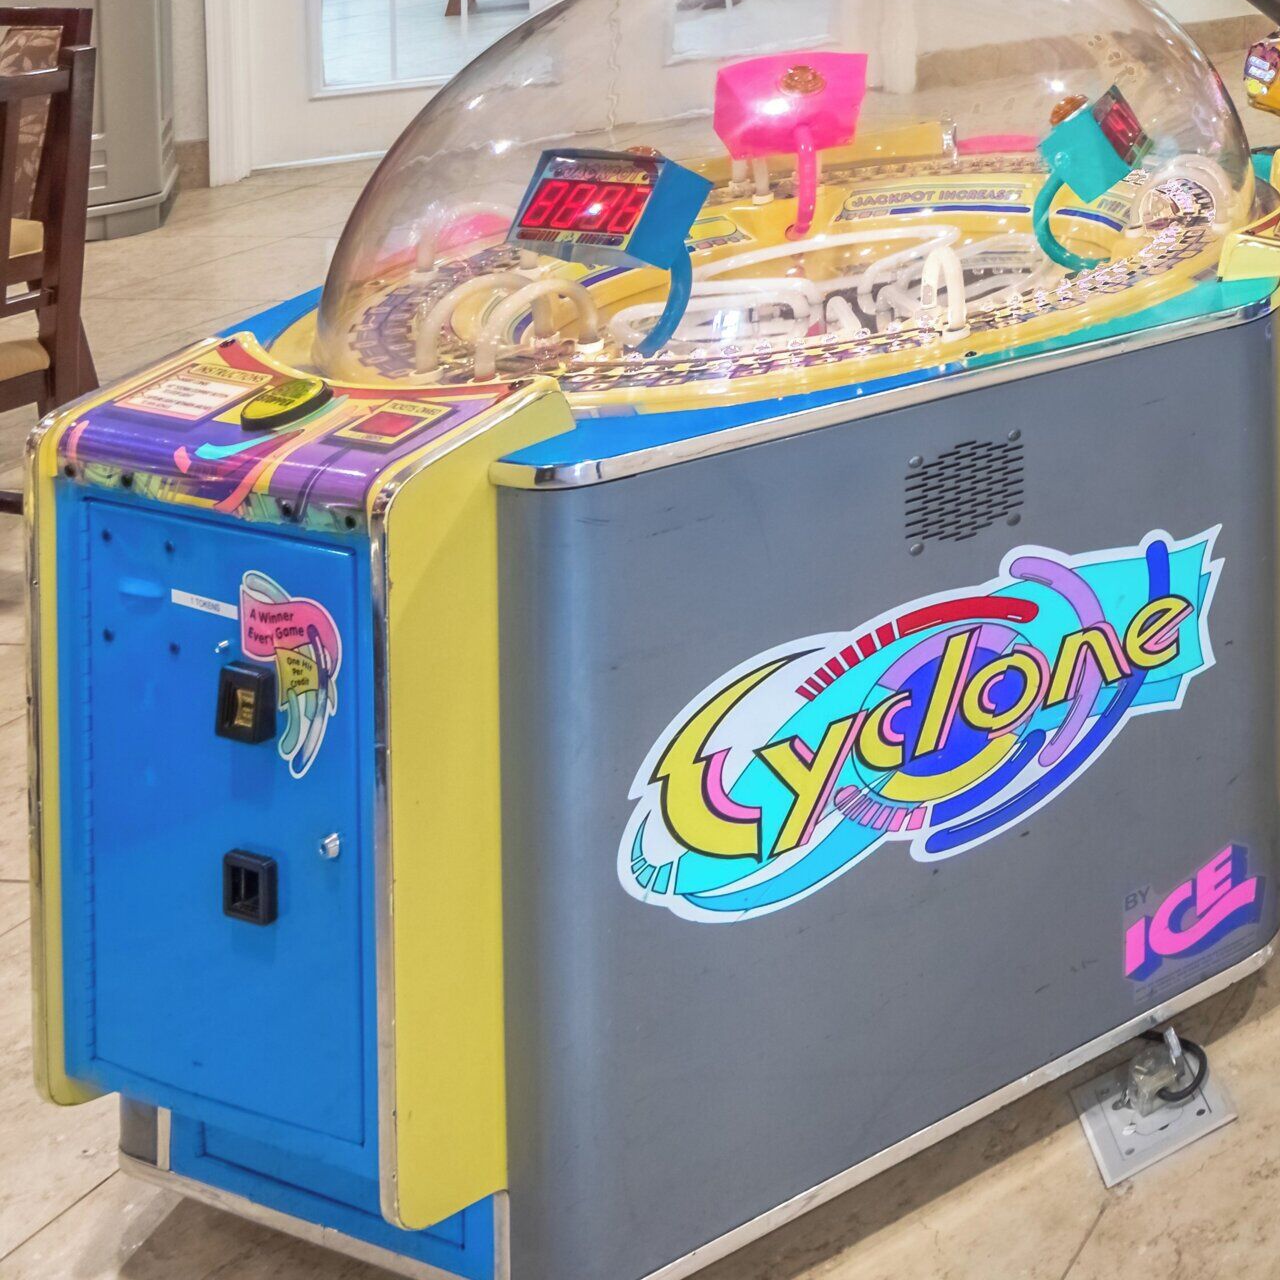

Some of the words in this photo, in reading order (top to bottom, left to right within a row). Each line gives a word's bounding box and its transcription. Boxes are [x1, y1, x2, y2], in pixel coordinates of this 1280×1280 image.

[558, 163, 640, 183] JACKPOT
[852, 190, 935, 208] JACKPOT
[250, 608, 256, 619] A
[259, 610, 294, 624] Winner
[248, 626, 274, 646] Every
[275, 626, 305, 641] Game
[287, 656, 300, 667] One
[292, 667, 303, 677] Per
[290, 677, 309, 688] Credit
[650, 595, 1194, 861] Cyclone
[1125, 886, 1150, 911] BY
[1124, 844, 1260, 980] ICE
